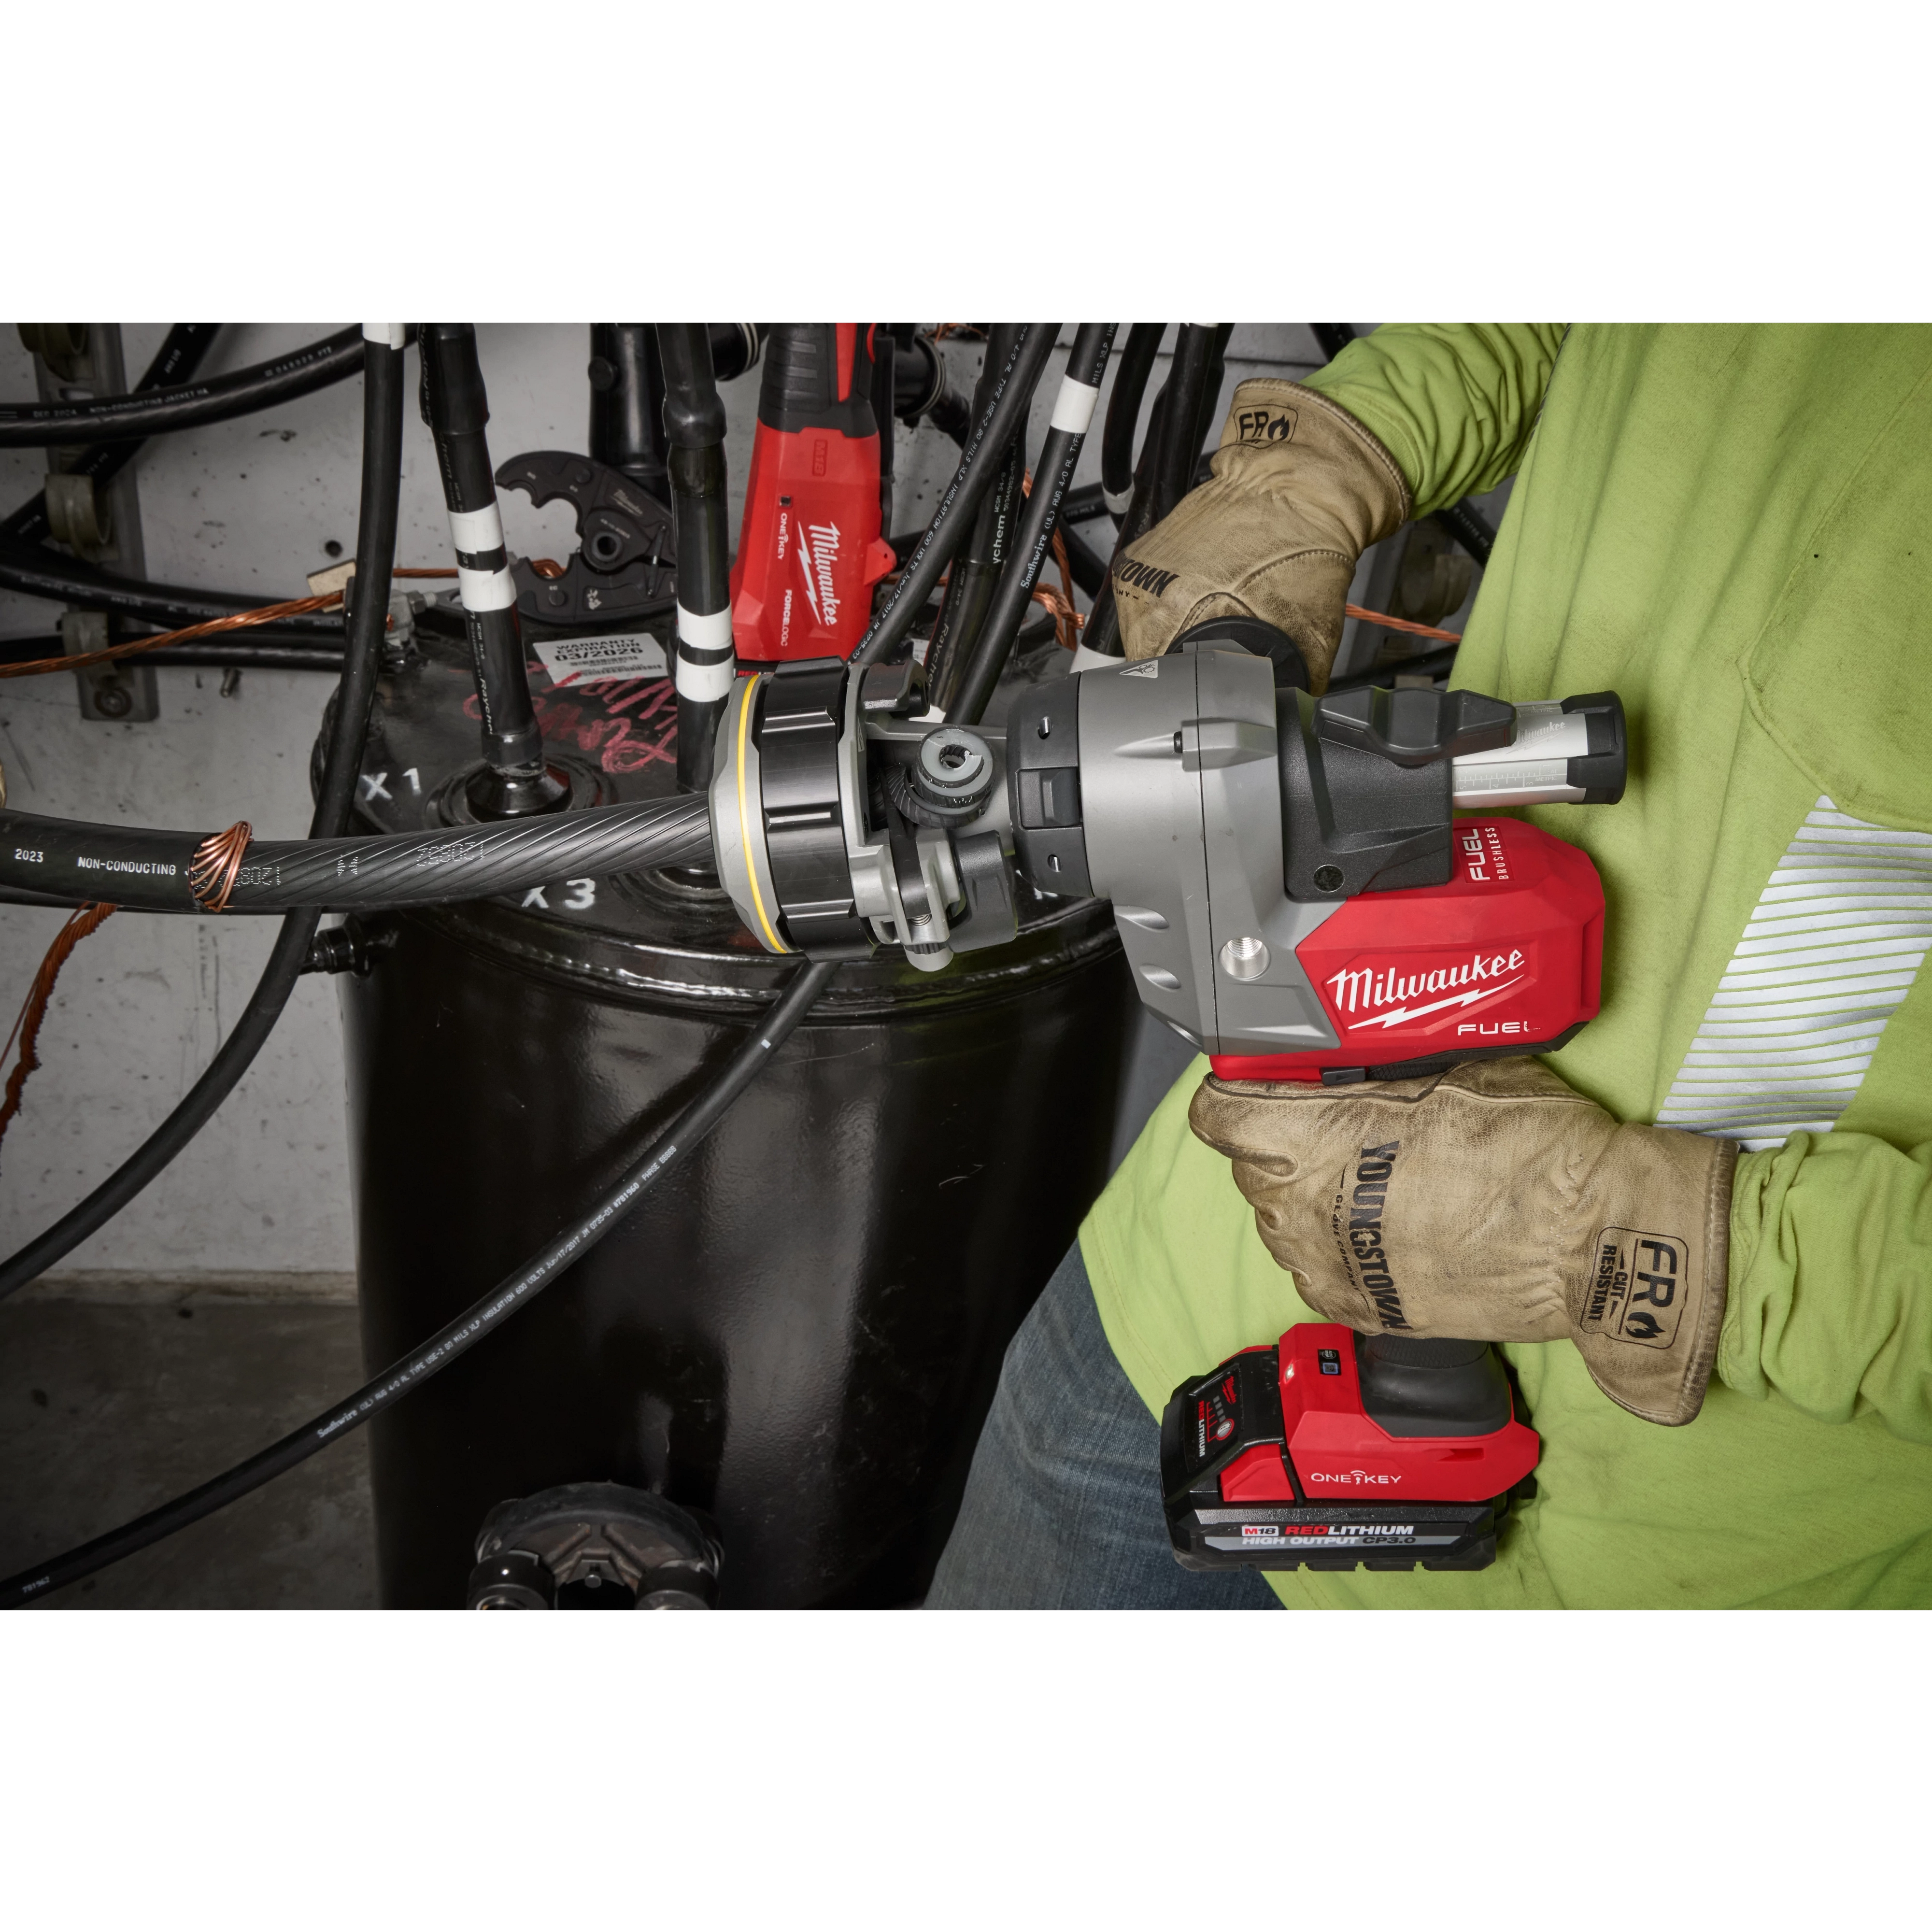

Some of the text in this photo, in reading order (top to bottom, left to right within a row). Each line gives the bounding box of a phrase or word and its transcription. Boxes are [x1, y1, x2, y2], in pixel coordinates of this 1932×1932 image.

[1004, 363, 1012, 373] AL
[994, 378, 1007, 399] TYPE
[982, 401, 996, 427] USE-2
[1239, 411, 1269, 440] FR
[976, 428, 984, 440] 80
[966, 441, 978, 463] MILS
[1021, 534, 1047, 588] Southwire
[1044, 510, 1056, 529] (UL)
[1052, 490, 1062, 507] AWG
[1065, 457, 1074, 468] AL
[1070, 433, 1081, 453] TYPE
[1091, 362, 1104, 384] MILS
[1099, 342, 1108, 358] XLP
[958, 464, 967, 481] XLP
[933, 483, 958, 529] INSULATION
[924, 530, 934, 546] 600
[993, 515, 1006, 564] ychem
[910, 547, 925, 571] VOLTS
[809, 522, 841, 626] Milwaukee
[781, 589, 793, 647] FORCELOGIC
[873, 618, 881, 630] JM
[555, 647, 643, 661] 03/2026
[556, 639, 635, 650] WARRANTY
[556, 642, 640, 654] EXPIRATION
[852, 630, 873, 660] 0735-03
[403, 768, 422, 795] 1
[14, 848, 44, 863] 2023
[77, 856, 177, 876] NON-CONDUCTING
[1462, 829, 1491, 881] FUEL
[1485, 827, 1509, 880] BRUSHLESS
[565, 878, 596, 909] 3
[1326, 949, 1525, 1013] Milwaukee
[1458, 1021, 1540, 1036] FUEL
[1332, 1194, 1361, 1293] GLOVE COMPANY
[1349, 1140, 1414, 1330] YOUNGSTOWN
[1588, 1244, 1617, 1321] RESISTANT
[1610, 1271, 1628, 1300] CUT
[1632, 1239, 1677, 1307] FR
[317, 1409, 358, 1438] Southwire
[359, 1398, 374, 1411] (UL)
[375, 1389, 387, 1400] AWG
[400, 1375, 411, 1383] AL
[410, 1362, 426, 1376] TYPE
[425, 1348, 445, 1364] USE-2
[444, 1341, 454, 1350] 80
[453, 1329, 469, 1343] MILS
[469, 1320, 481, 1332] XLP
[482, 1292, 516, 1321] INSULATION
[515, 1282, 527, 1295] 600
[526, 1267, 545, 1284] VOLTS
[581, 1227, 590, 1238] JM
[589, 1207, 613, 1230] 0735-03
[613, 1181, 640, 1208] #781960
[641, 1162, 660, 1181] PHASE
[1242, 1536, 1416, 1545] HIGH OUTPUT CP3.0
[1285, 1525, 1414, 1535] REDLITHIUM
